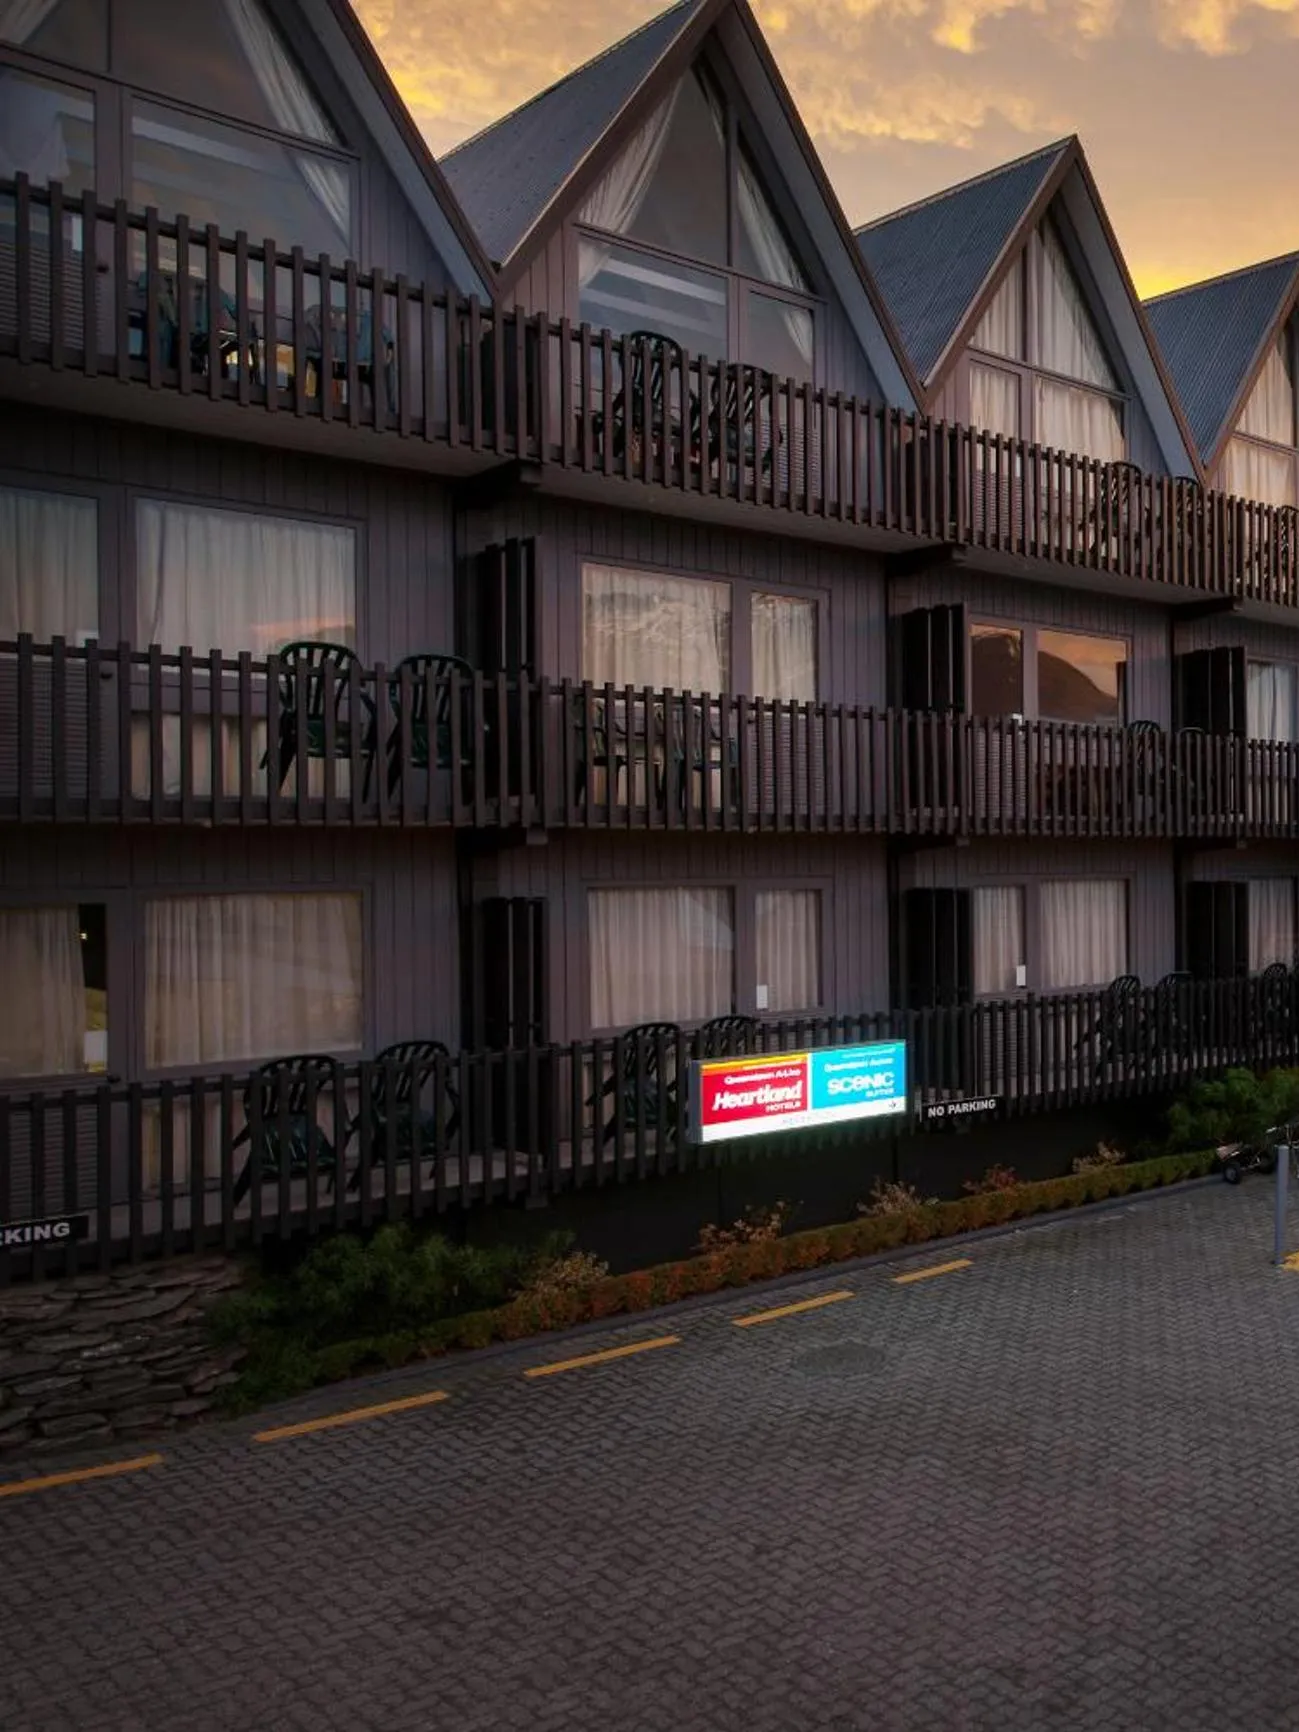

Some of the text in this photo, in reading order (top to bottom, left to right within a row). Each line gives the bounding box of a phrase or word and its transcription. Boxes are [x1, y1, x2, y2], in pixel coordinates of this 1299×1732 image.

[712, 1079, 803, 1111] Heartland
[928, 1099, 996, 1118] NO PARKING
[0, 1222, 70, 1246] KING
